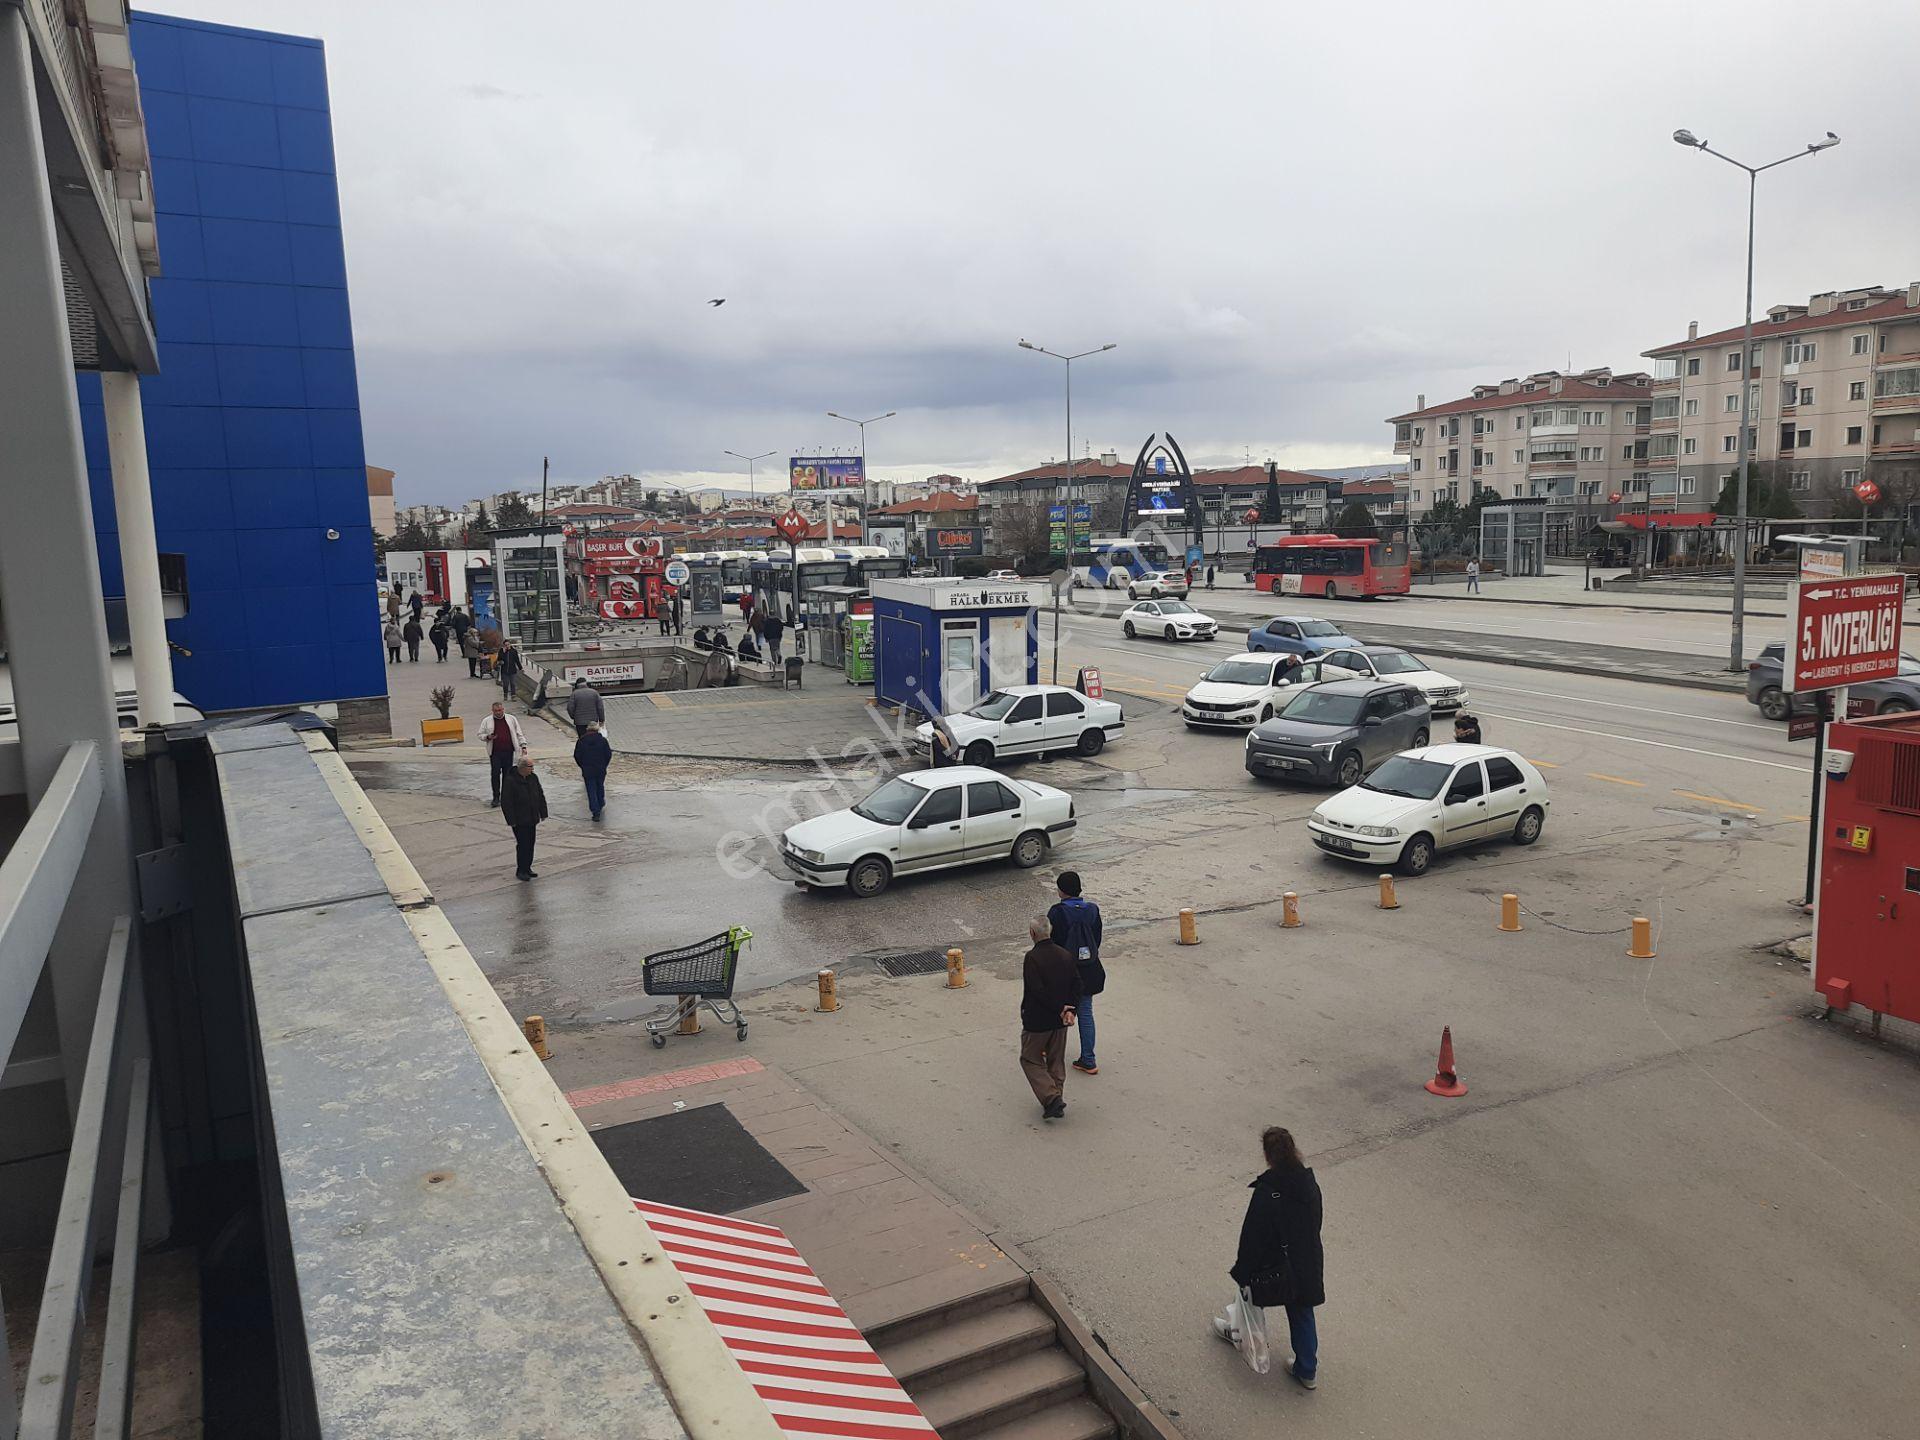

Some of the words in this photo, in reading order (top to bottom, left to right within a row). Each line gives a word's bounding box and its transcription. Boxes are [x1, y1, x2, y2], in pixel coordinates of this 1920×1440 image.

[784, 516, 799, 526] M
[587, 542, 607, 553] BAŞER
[608, 542, 624, 552] BÜFE
[1834, 588, 1848, 599] T.C.
[1850, 583, 1900, 598] YENİMAHALLE
[950, 596, 980, 606] HALK
[988, 594, 1029, 604] EKMEK
[1802, 615, 1816, 661] 5.
[1819, 601, 1897, 659] NOTERLİĞİ
[587, 665, 635, 676] BATIKENT
[1812, 664, 1843, 679] LABİRENT
[1851, 657, 1877, 674] MERKEZİ
